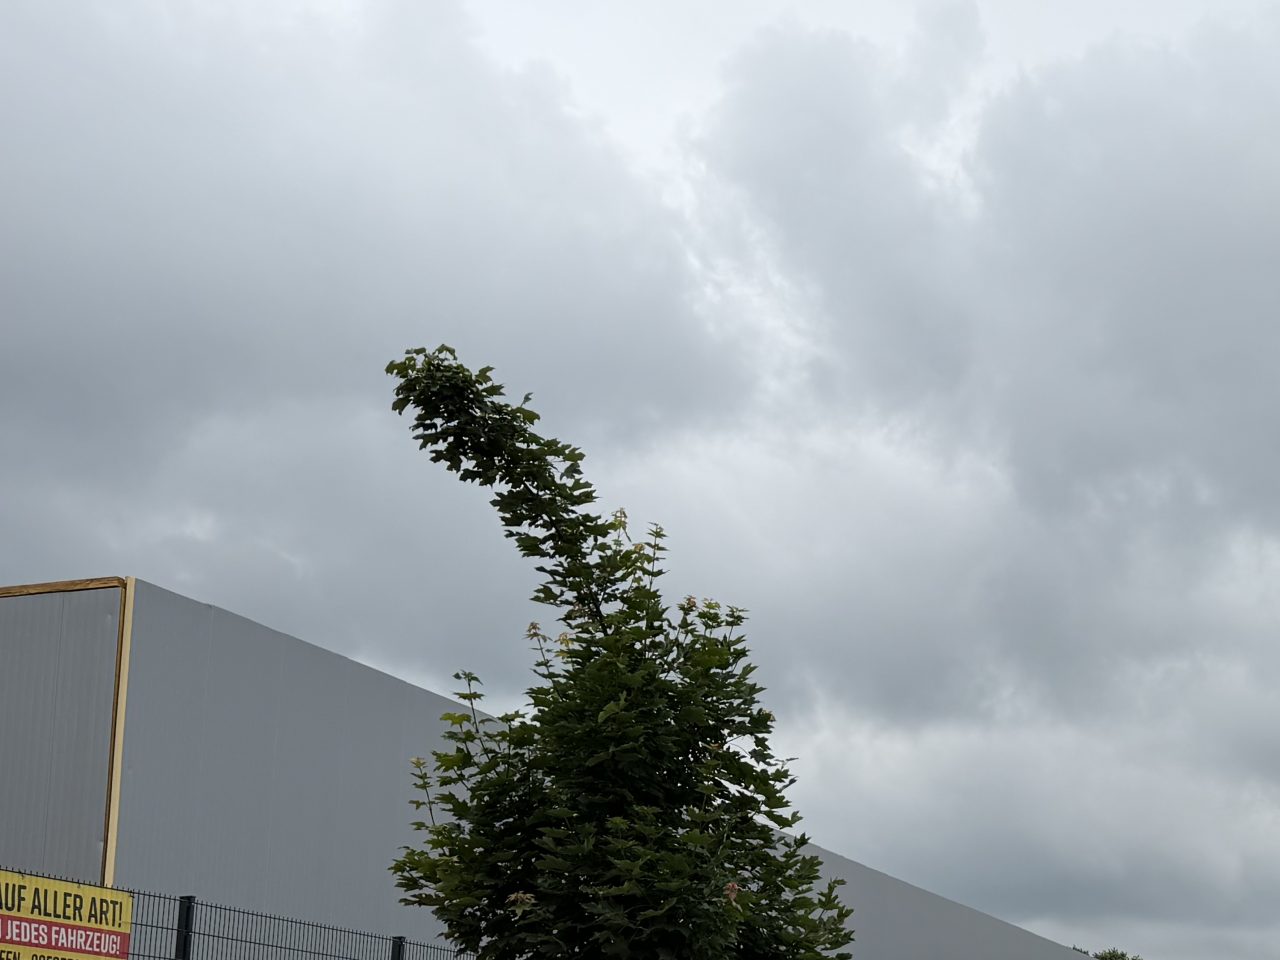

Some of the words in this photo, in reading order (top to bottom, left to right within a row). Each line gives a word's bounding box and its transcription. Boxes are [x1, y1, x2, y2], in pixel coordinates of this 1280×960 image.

[0, 882, 27, 912] UF
[30, 887, 83, 923] ALLER
[88, 896, 123, 928] ART!
[5, 919, 48, 945] JEDES
[51, 926, 121, 955] FAHRZEUG!
